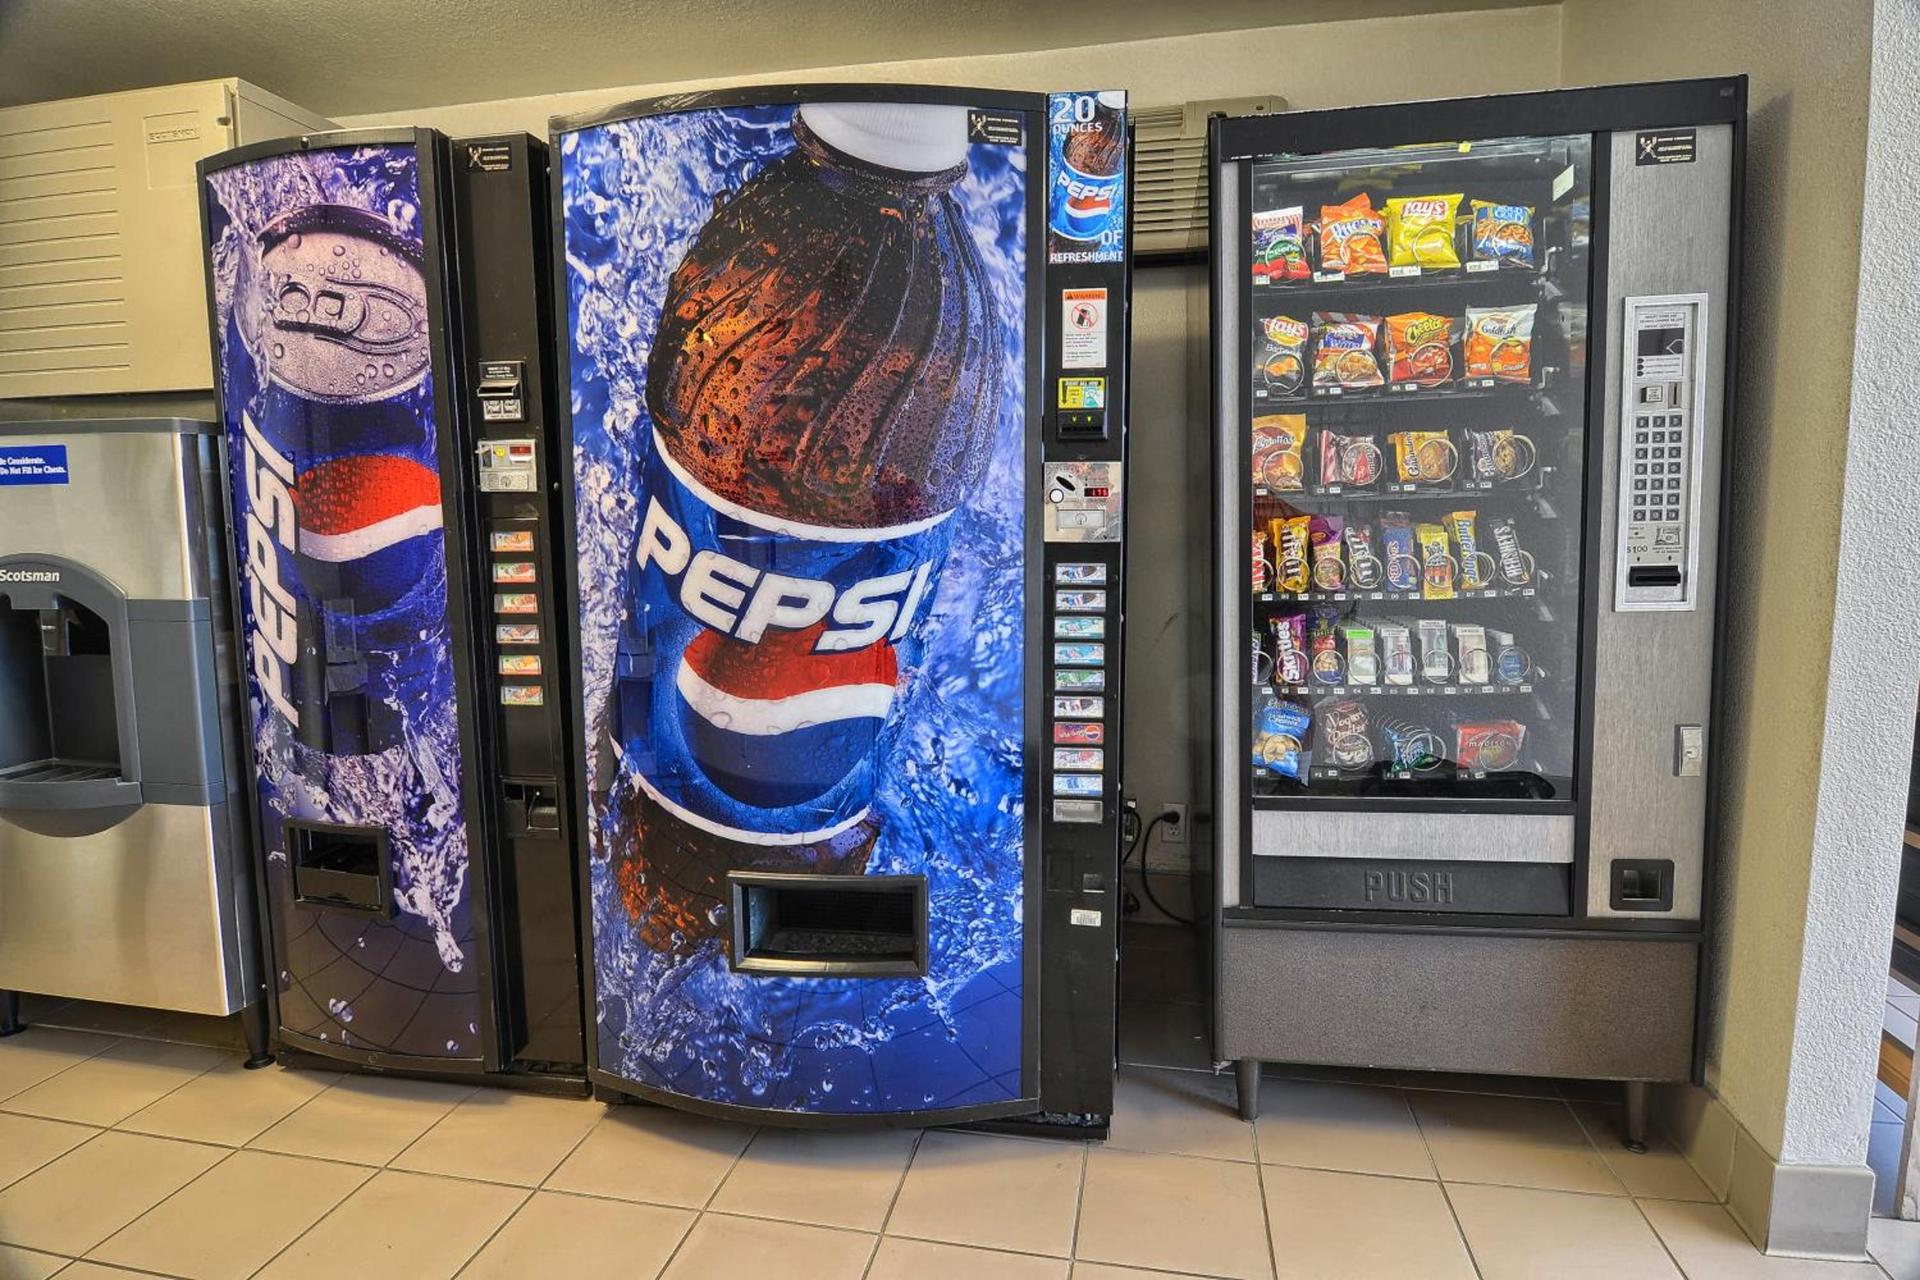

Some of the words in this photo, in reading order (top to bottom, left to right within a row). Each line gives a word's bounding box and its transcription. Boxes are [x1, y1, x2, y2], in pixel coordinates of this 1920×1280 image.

[1054, 96, 1095, 123] 20
[1053, 122, 1103, 133] OUNCES
[1057, 171, 1117, 201] PEPSI
[1101, 230, 1122, 244] OF
[1050, 252, 1124, 264] REFRESHMENT
[0, 569, 60, 582] Scotsman
[243, 408, 299, 727] PEPSI
[636, 495, 933, 651] PEPSI
[1364, 870, 1454, 904] PUSH
